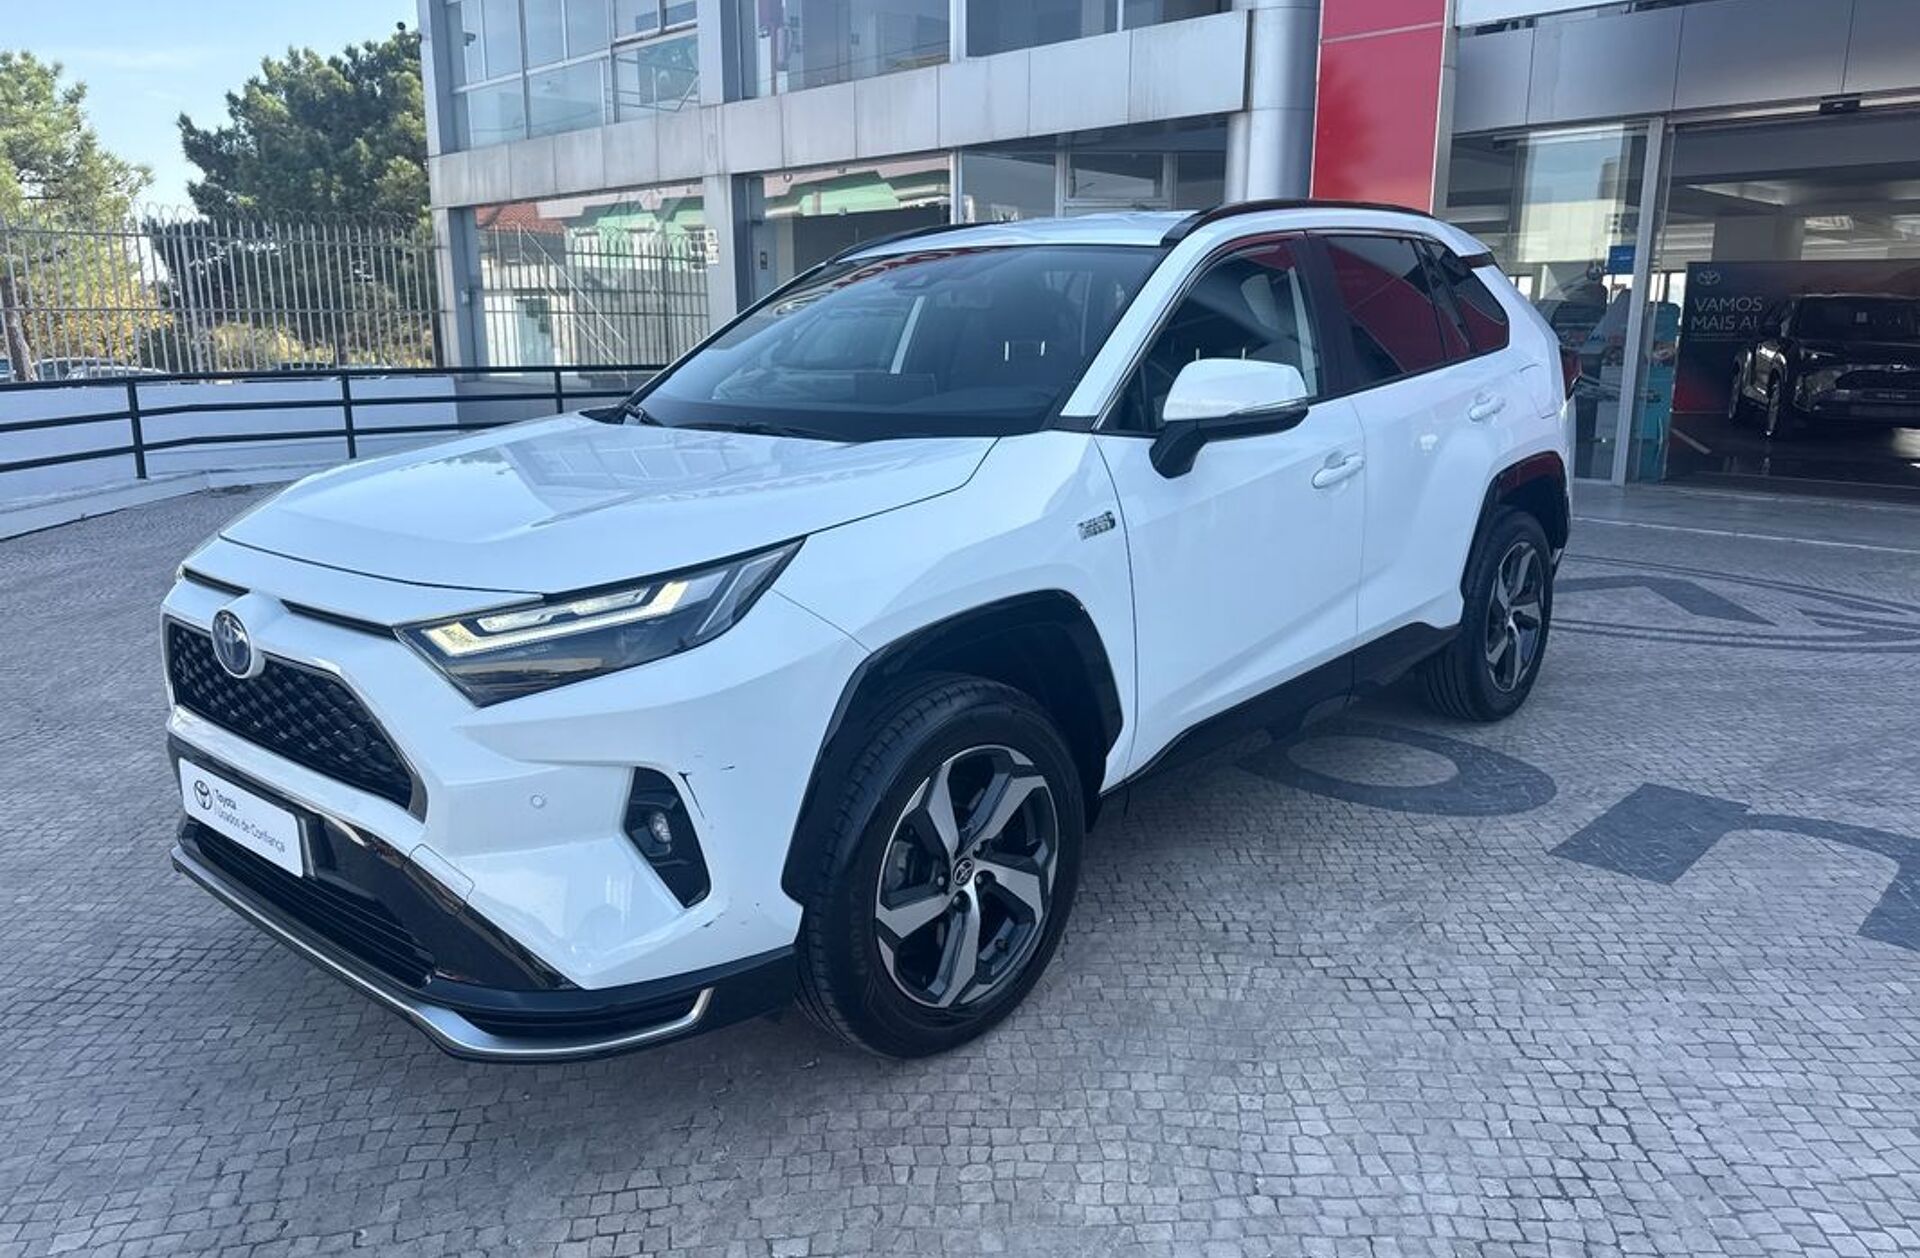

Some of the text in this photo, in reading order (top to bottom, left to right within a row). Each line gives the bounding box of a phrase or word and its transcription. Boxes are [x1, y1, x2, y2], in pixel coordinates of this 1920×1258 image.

[1694, 296, 1763, 312] VAMOS
[1690, 315, 1736, 330] MAIS
[213, 788, 238, 811] Toyota
